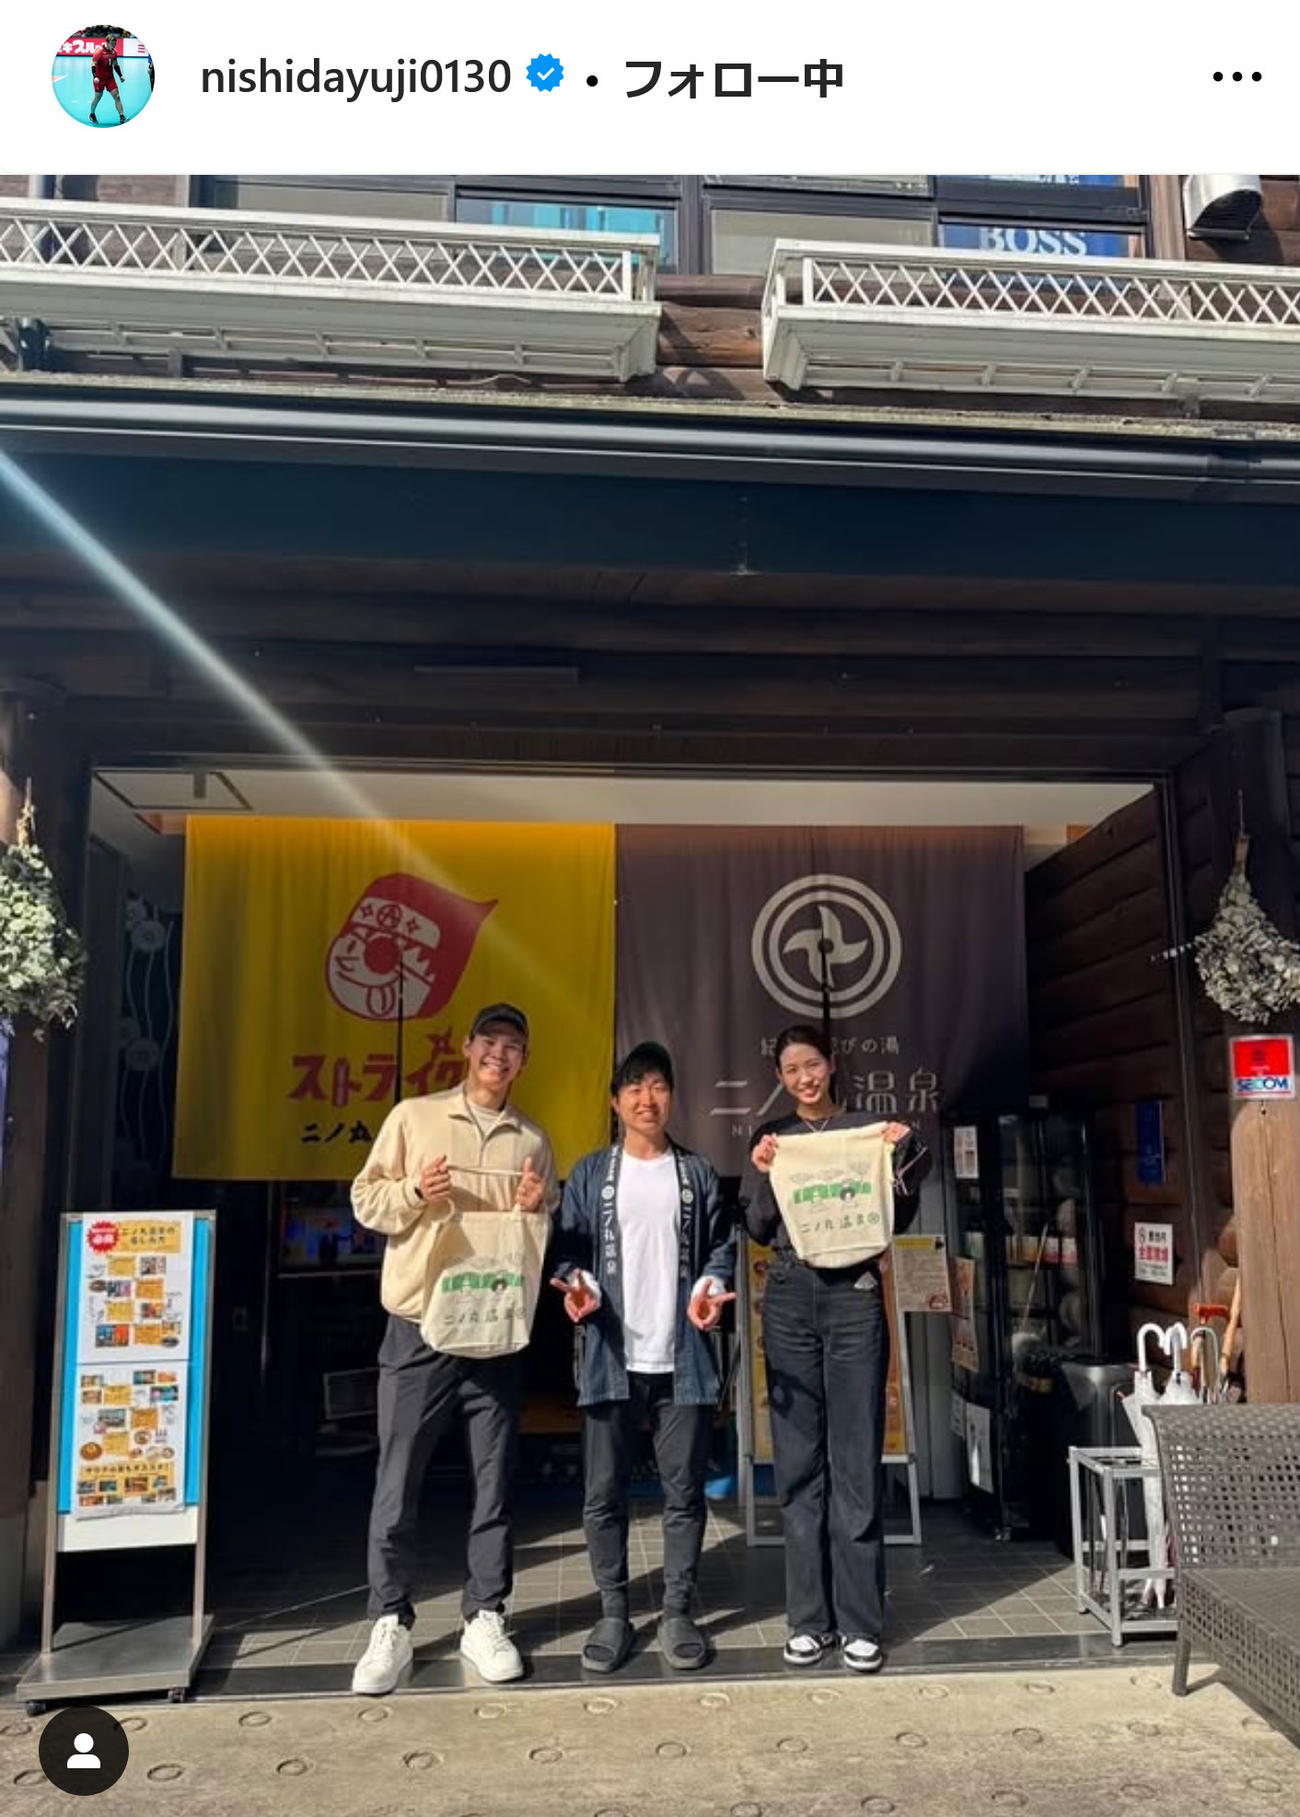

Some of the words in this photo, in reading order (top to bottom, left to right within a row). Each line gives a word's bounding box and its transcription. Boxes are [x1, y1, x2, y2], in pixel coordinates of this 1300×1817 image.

[980, 226, 1087, 256] BOSS
[287, 1031, 464, 1107] ストライク
[1237, 1077, 1289, 1091] SECOM
[711, 1068, 940, 1115] 二ノ温泉
